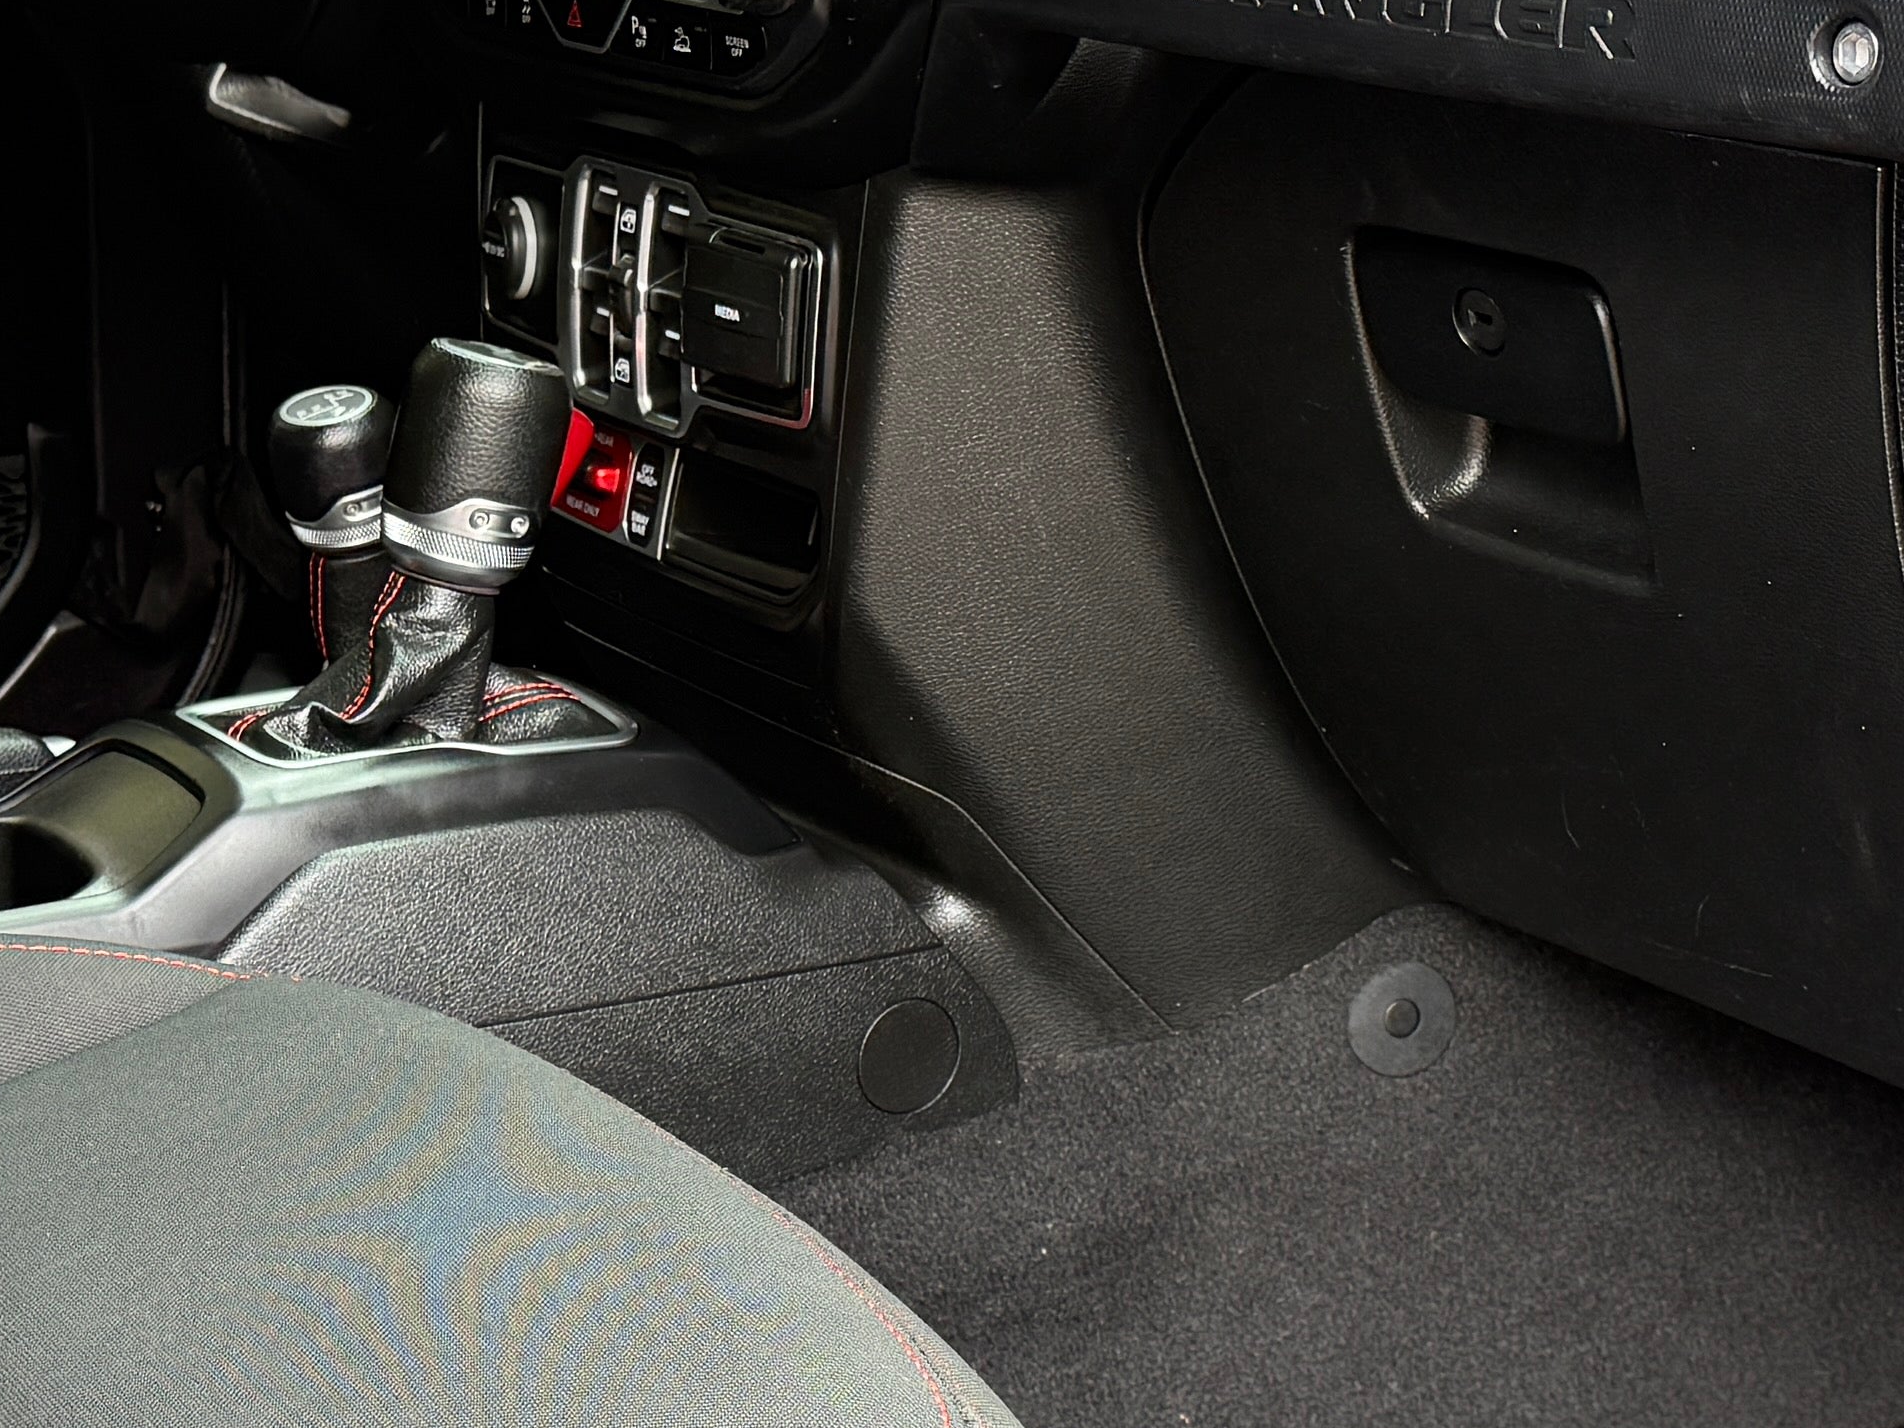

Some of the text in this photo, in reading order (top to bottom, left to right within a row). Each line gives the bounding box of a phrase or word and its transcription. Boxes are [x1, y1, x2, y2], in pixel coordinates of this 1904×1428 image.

[725, 35, 749, 49] SCREEN
[731, 48, 743, 57] OFF
[714, 304, 740, 322] MEDIA
